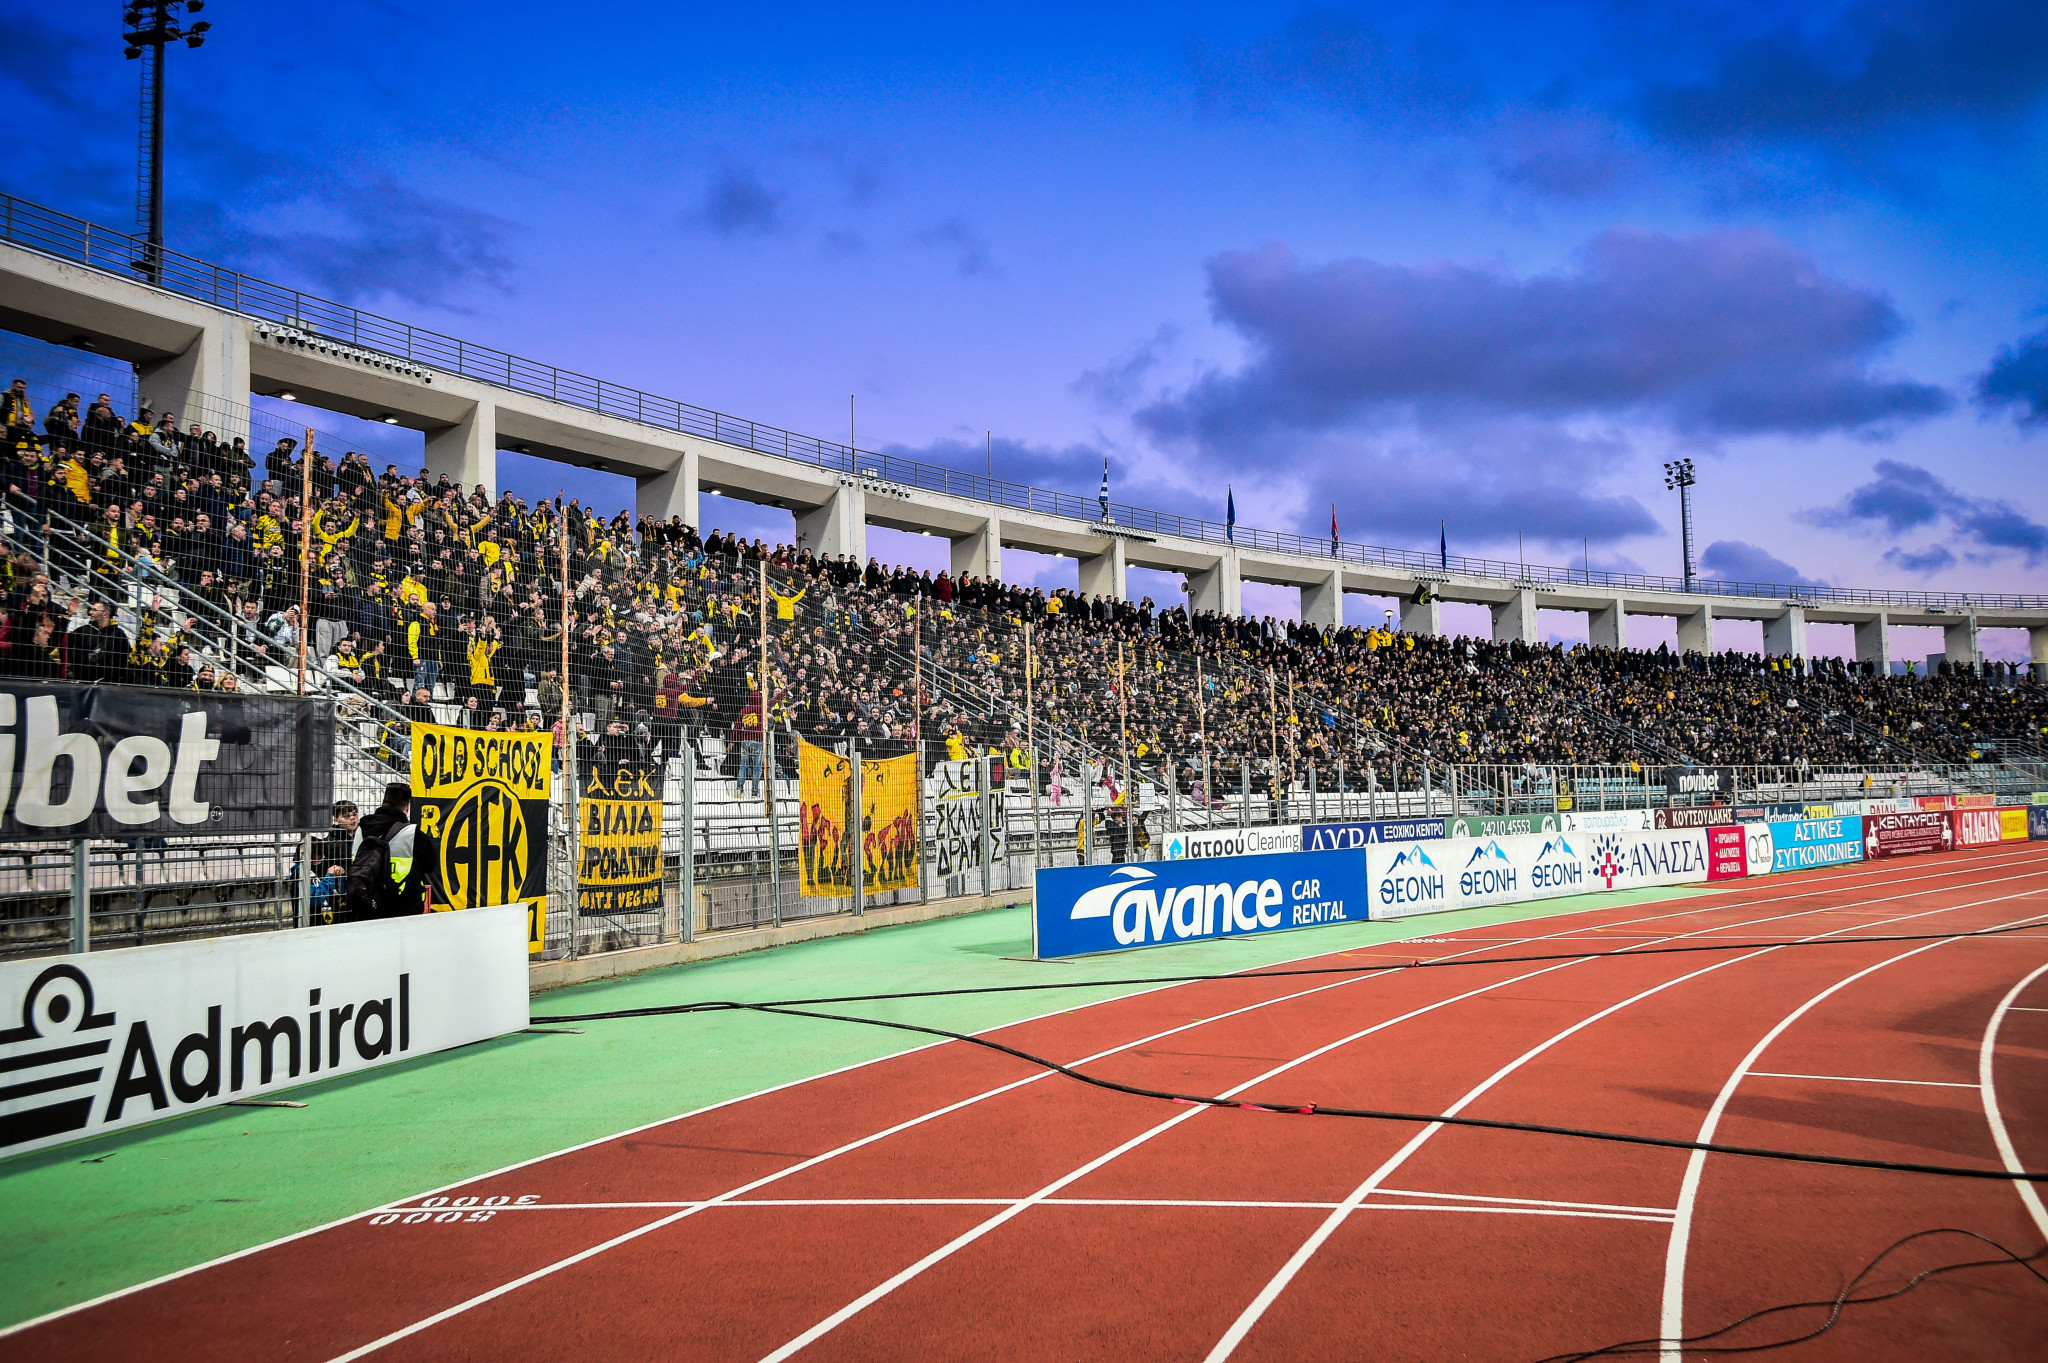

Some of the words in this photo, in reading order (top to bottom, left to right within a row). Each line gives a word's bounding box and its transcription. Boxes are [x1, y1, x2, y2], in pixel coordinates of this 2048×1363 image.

[421, 733, 468, 790] OLD
[473, 736, 544, 791] SCHOOL
[1679, 768, 1720, 792] novibet
[1481, 821, 1506, 837] 24210
[1507, 819, 1531, 835] 45553
[1672, 808, 1733, 827] ΚΟΥΤΣΟΥΔΑΚΗΣ
[1794, 819, 1844, 842] ΑΣΤΙΚΕΣ
[1879, 813, 1941, 830] ΚΕΝΤΑΥΡΟΣ
[1383, 824, 1415, 840] ΕΞΟΧΙΚΟ
[1416, 822, 1444, 837] ΚΕΝΤΡΟ
[937, 828, 1003, 877] ΔΡΑΜΣ
[1185, 830, 1244, 859] Ιατρού
[1247, 831, 1300, 852] Cleaning
[1775, 840, 1862, 869] ΣΥΓΚΟΙΝΩΝΙΕΣ
[1530, 861, 1582, 888] ΘΕΟΝΗ
[1719, 861, 1741, 873] ΘΕΡΑΠΕΙΑ
[1291, 878, 1321, 901] CAR
[1379, 874, 1444, 905] ΘΕΟΝΗ
[1459, 867, 1517, 896] ΘΕΟΝΗ
[1112, 878, 1283, 945] avance
[1292, 900, 1347, 925] RENTAL
[104, 973, 410, 1123] Admiral
